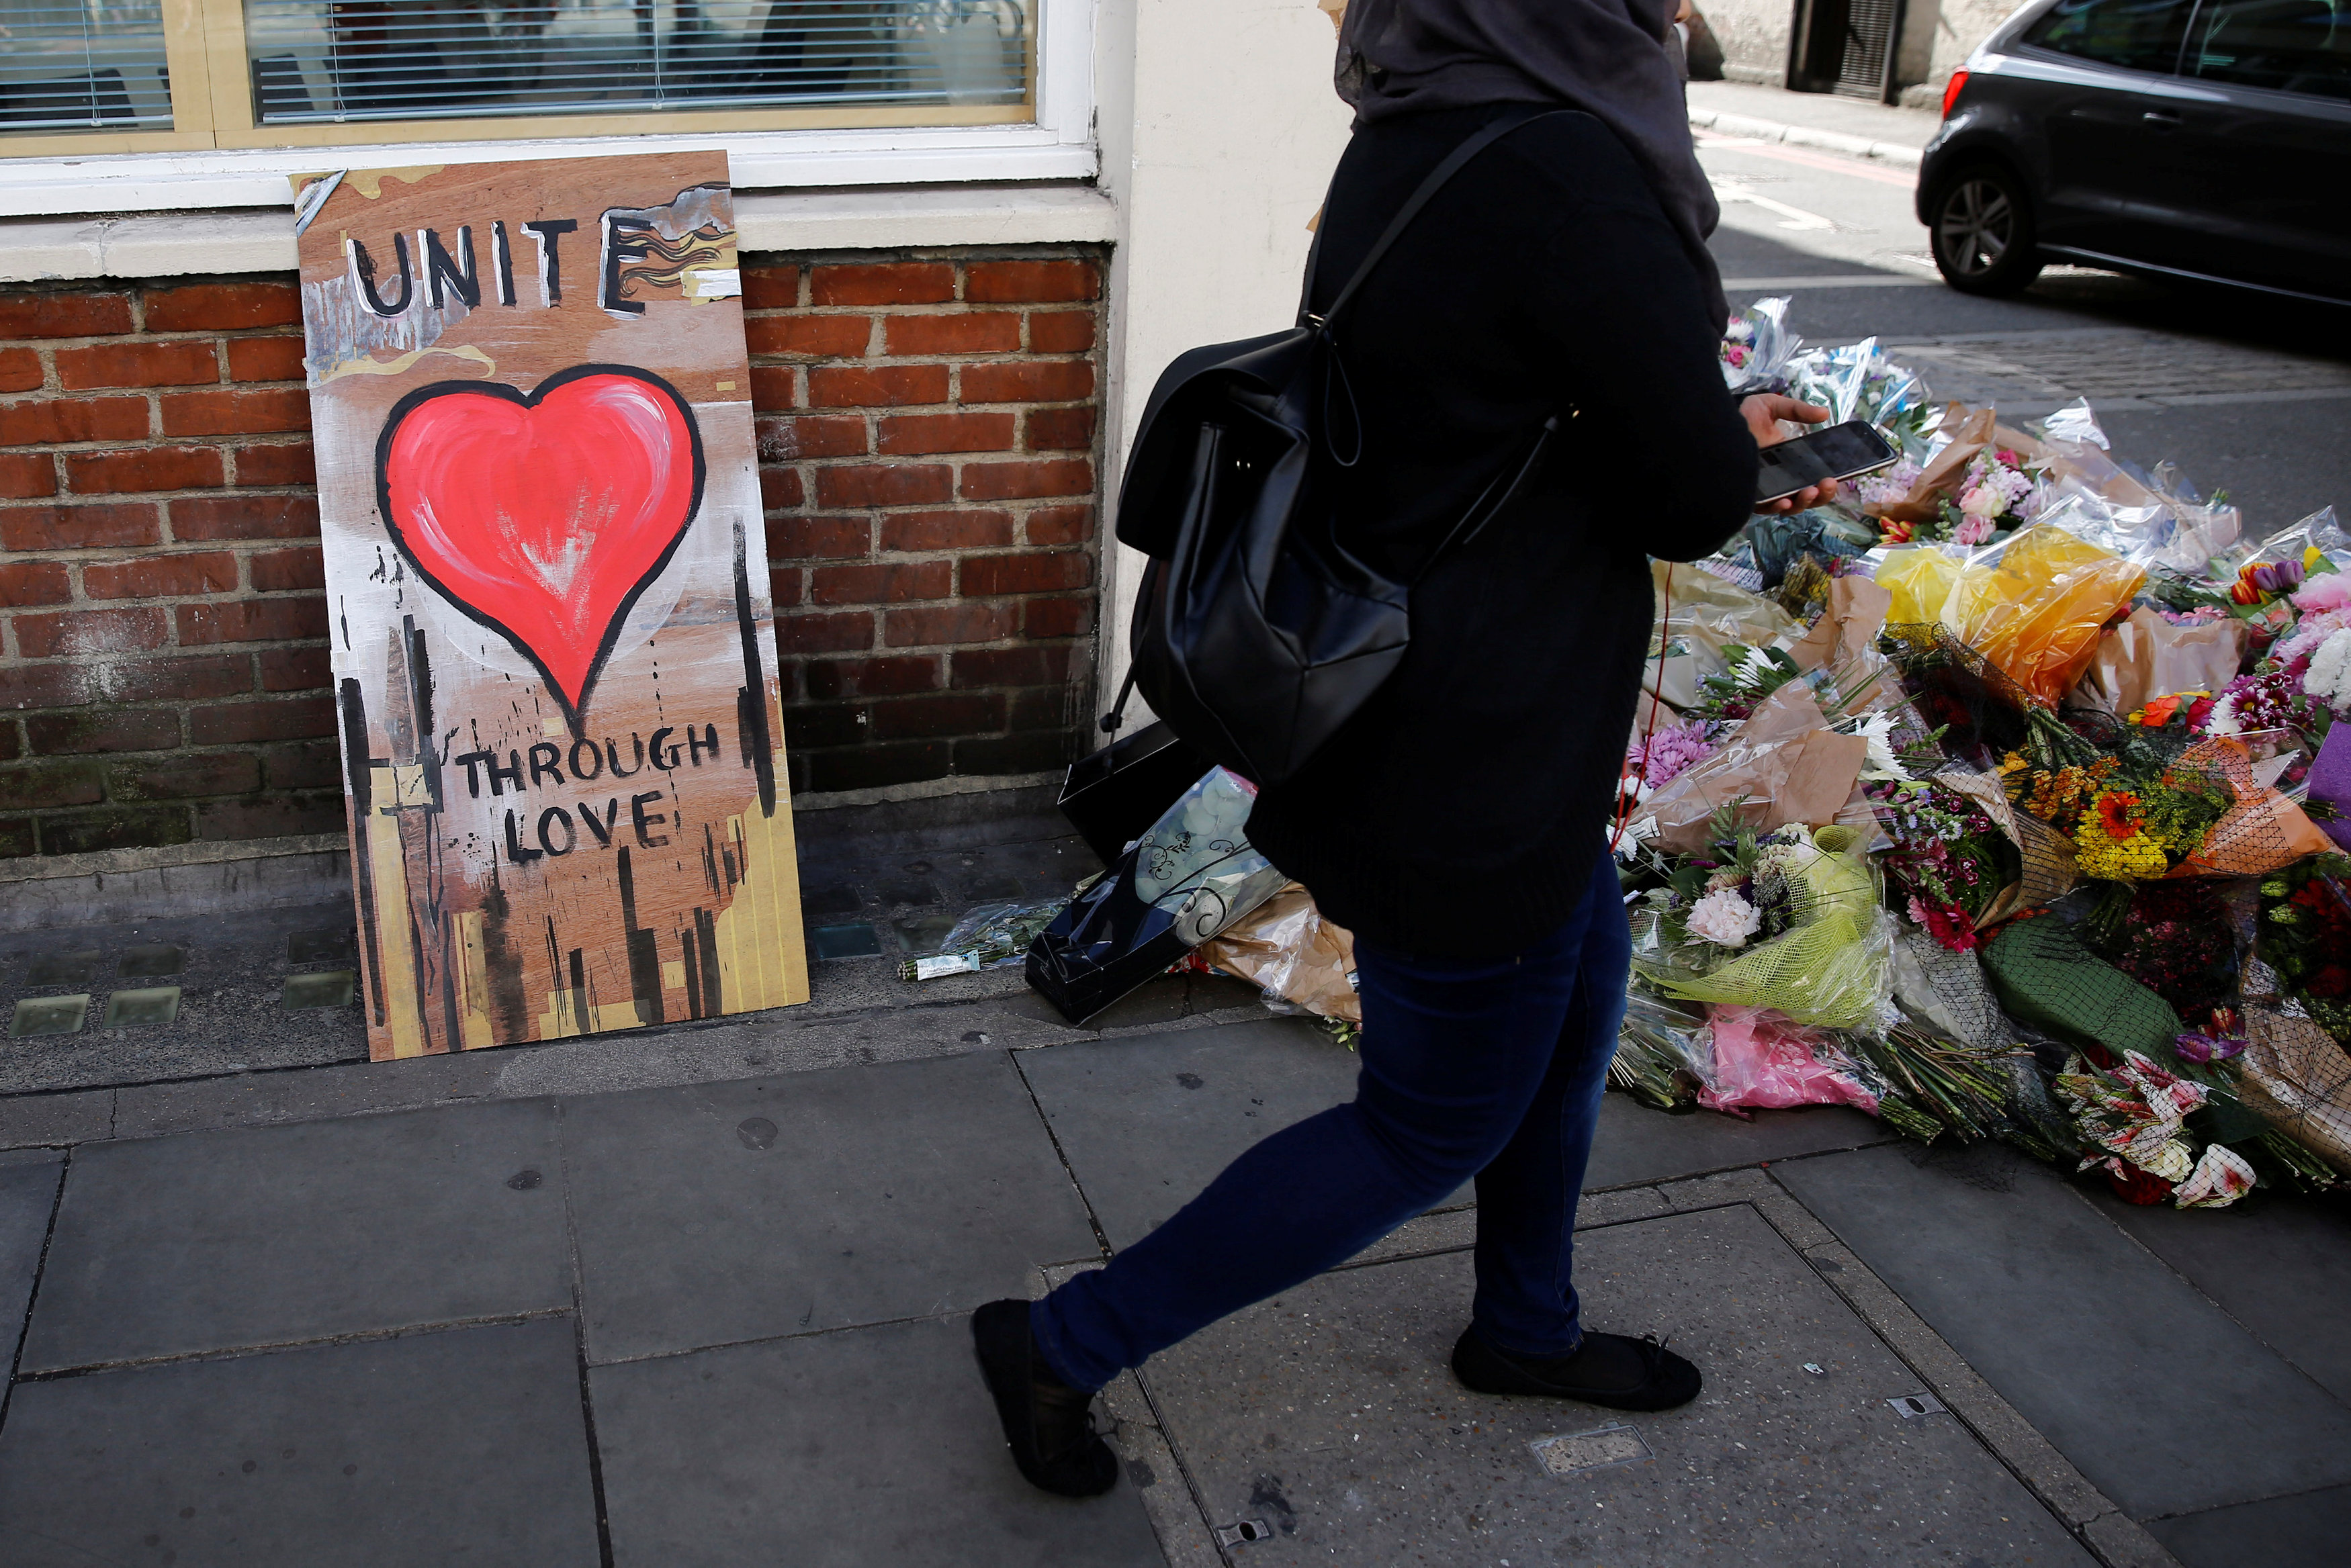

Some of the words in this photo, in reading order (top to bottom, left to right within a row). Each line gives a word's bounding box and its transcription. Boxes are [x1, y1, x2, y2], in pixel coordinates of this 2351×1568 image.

[345, 214, 652, 320] UNITE
[454, 723, 719, 798] THROUGH
[504, 790, 670, 863] LOVE
